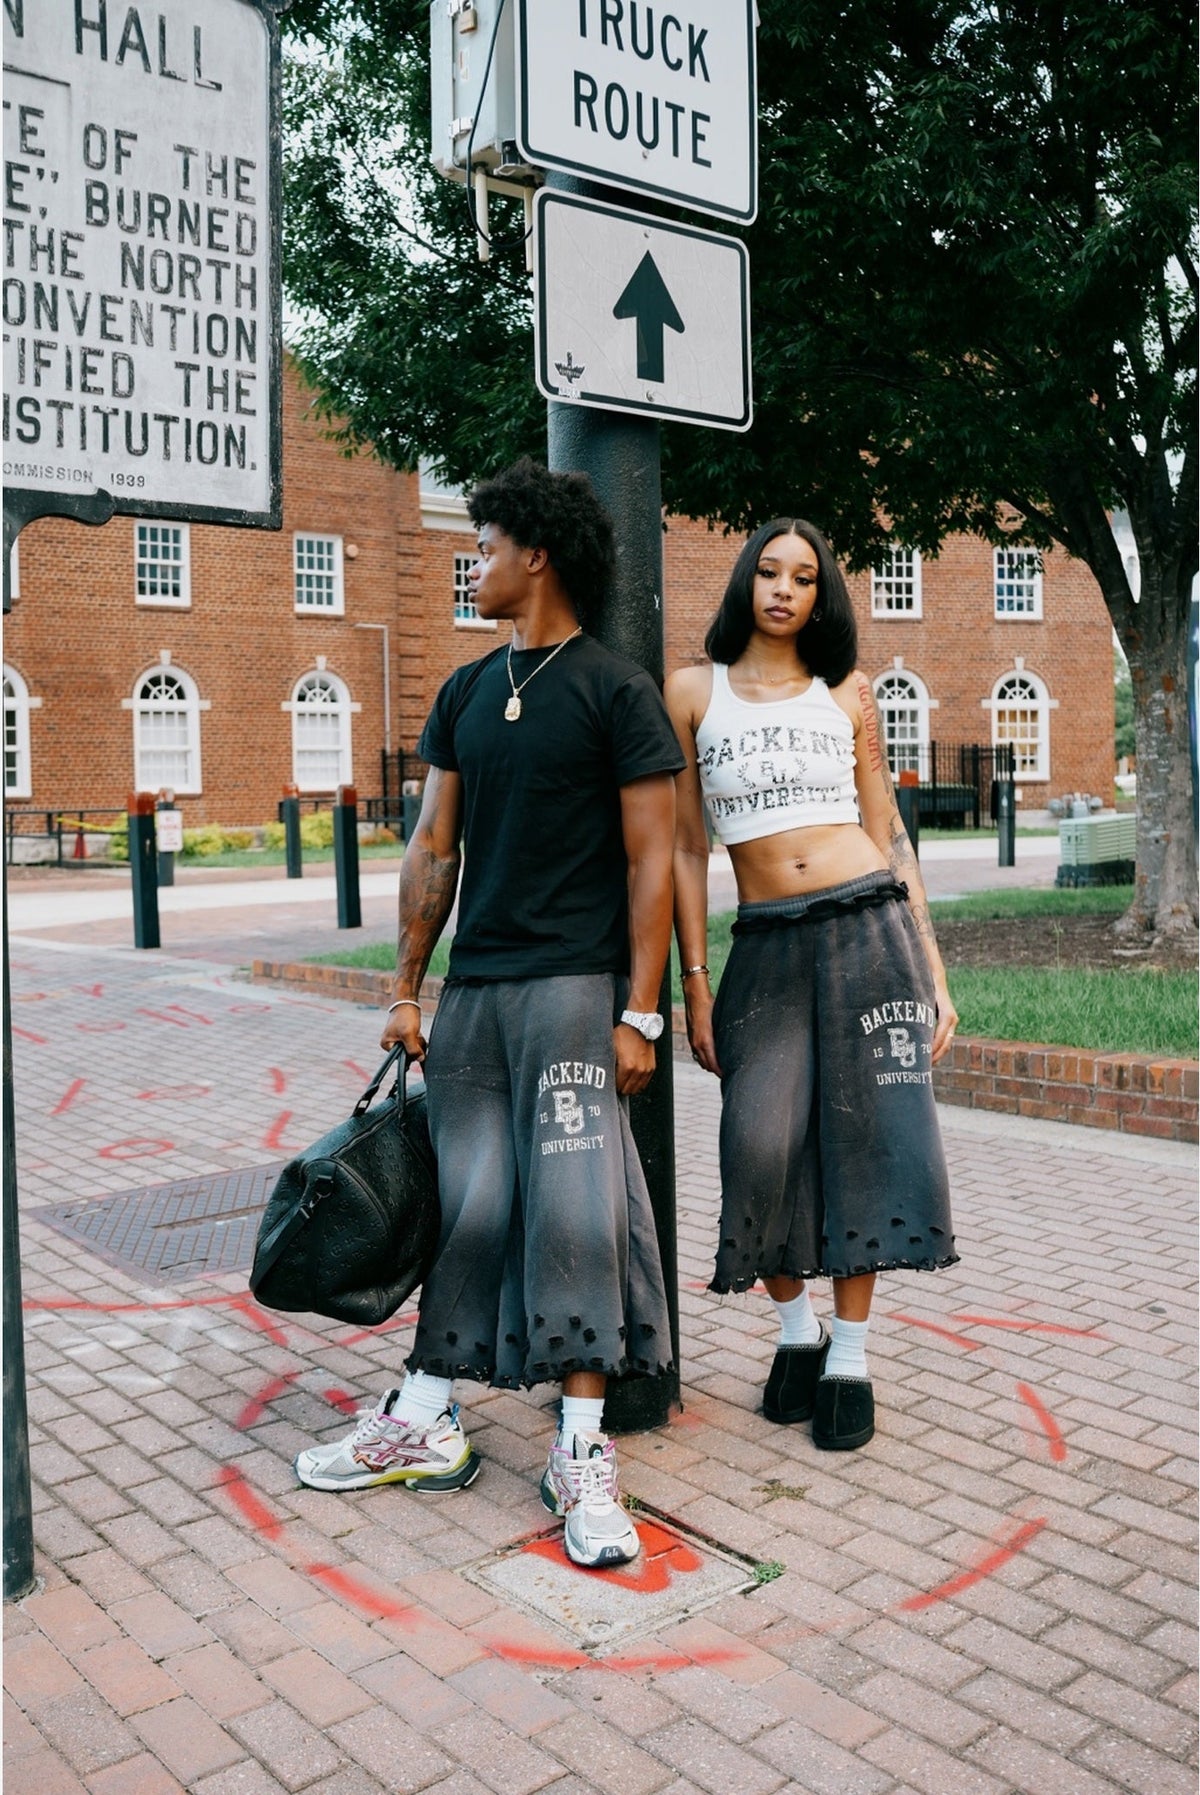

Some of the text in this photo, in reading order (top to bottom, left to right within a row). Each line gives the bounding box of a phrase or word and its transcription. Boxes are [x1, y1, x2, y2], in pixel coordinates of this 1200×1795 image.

[75, 0, 222, 91] HALL
[573, 70, 712, 168] ROUTE
[84, 123, 138, 174] OF
[174, 143, 256, 205] THE
[85, 178, 256, 257] BURNED
[3, 217, 257, 311] THE NORTH
[3, 277, 257, 364] ONVENTION
[3, 333, 256, 417] IFIED THE
[3, 462, 146, 488] OMMISSION 1939
[860, 1001, 934, 1035] BACKEND
[876, 1071, 932, 1085] UNIVERSITY
[541, 1135, 604, 1155] UNIVERSITY
